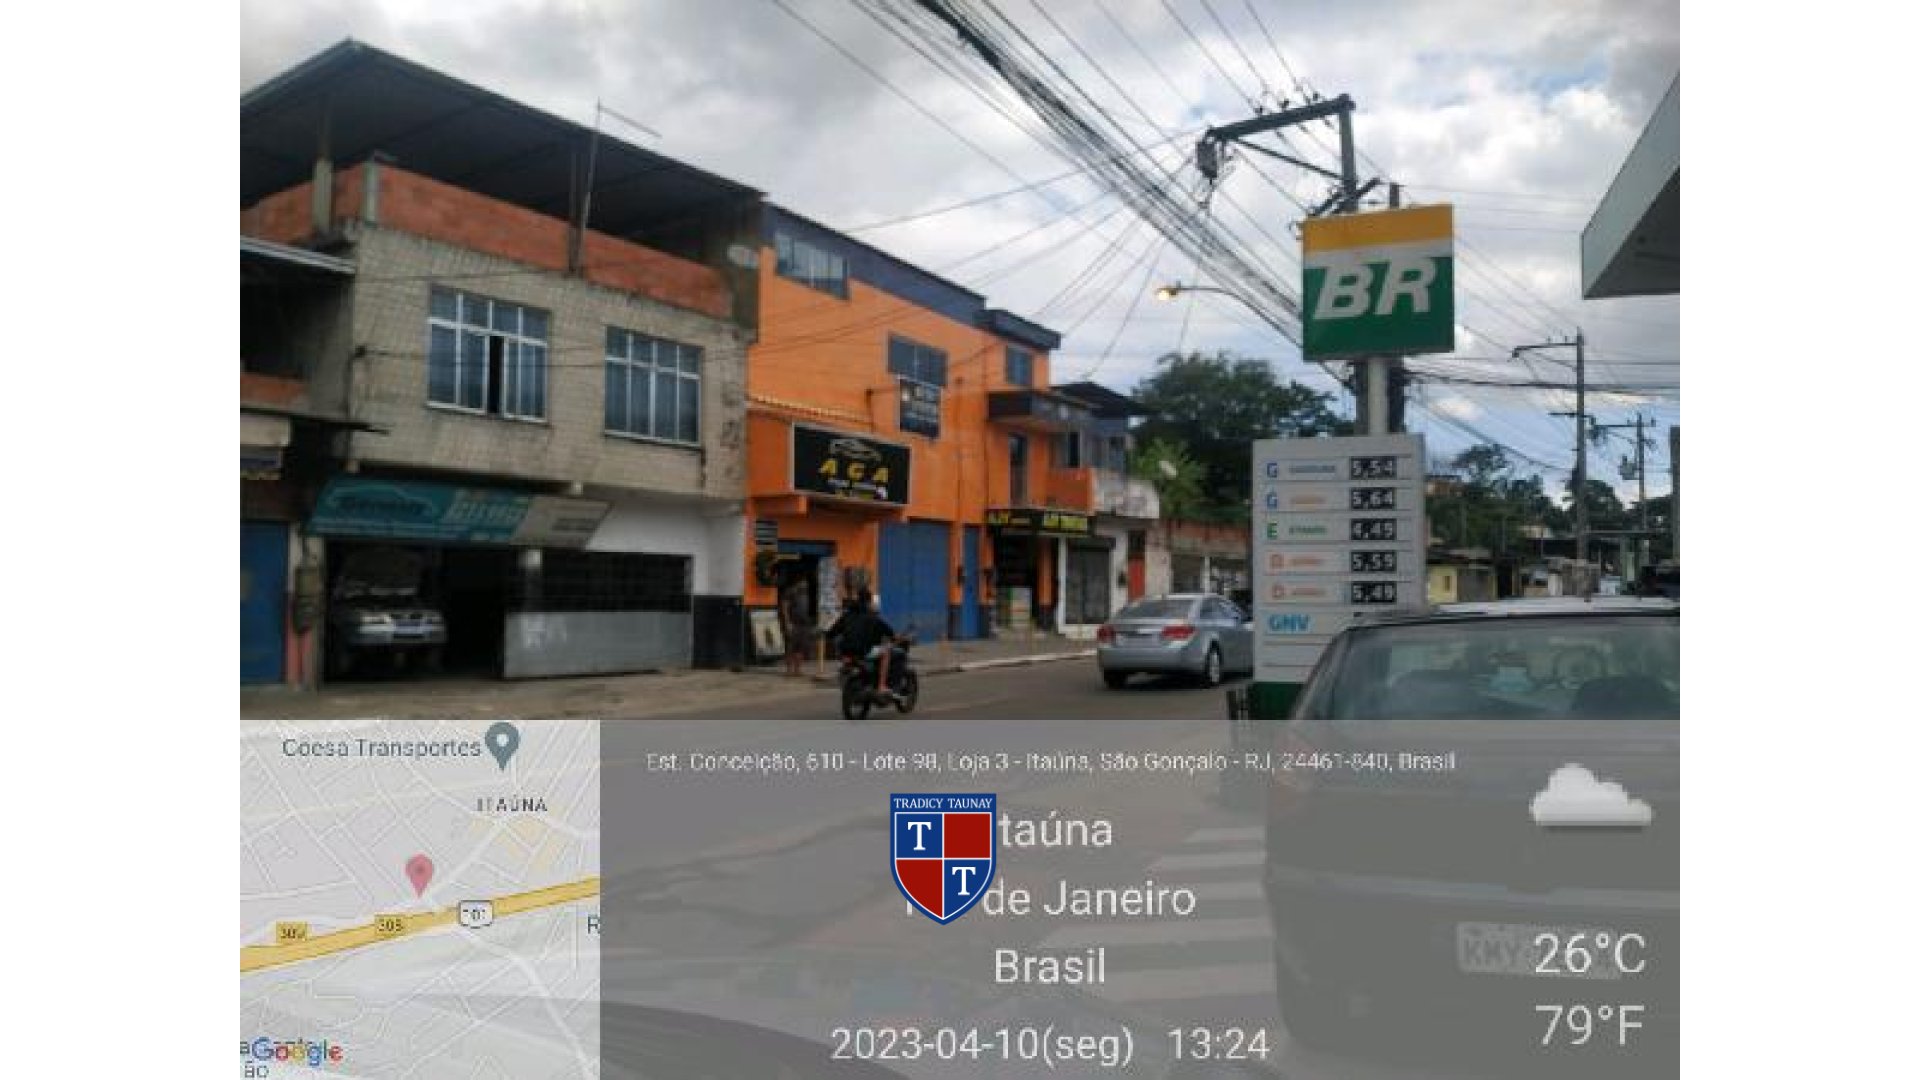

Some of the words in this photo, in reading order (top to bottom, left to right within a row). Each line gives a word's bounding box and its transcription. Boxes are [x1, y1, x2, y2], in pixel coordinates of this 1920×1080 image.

[1312, 257, 1437, 320] BR
[1267, 523, 1278, 539] E
[1269, 614, 1311, 632] GNV
